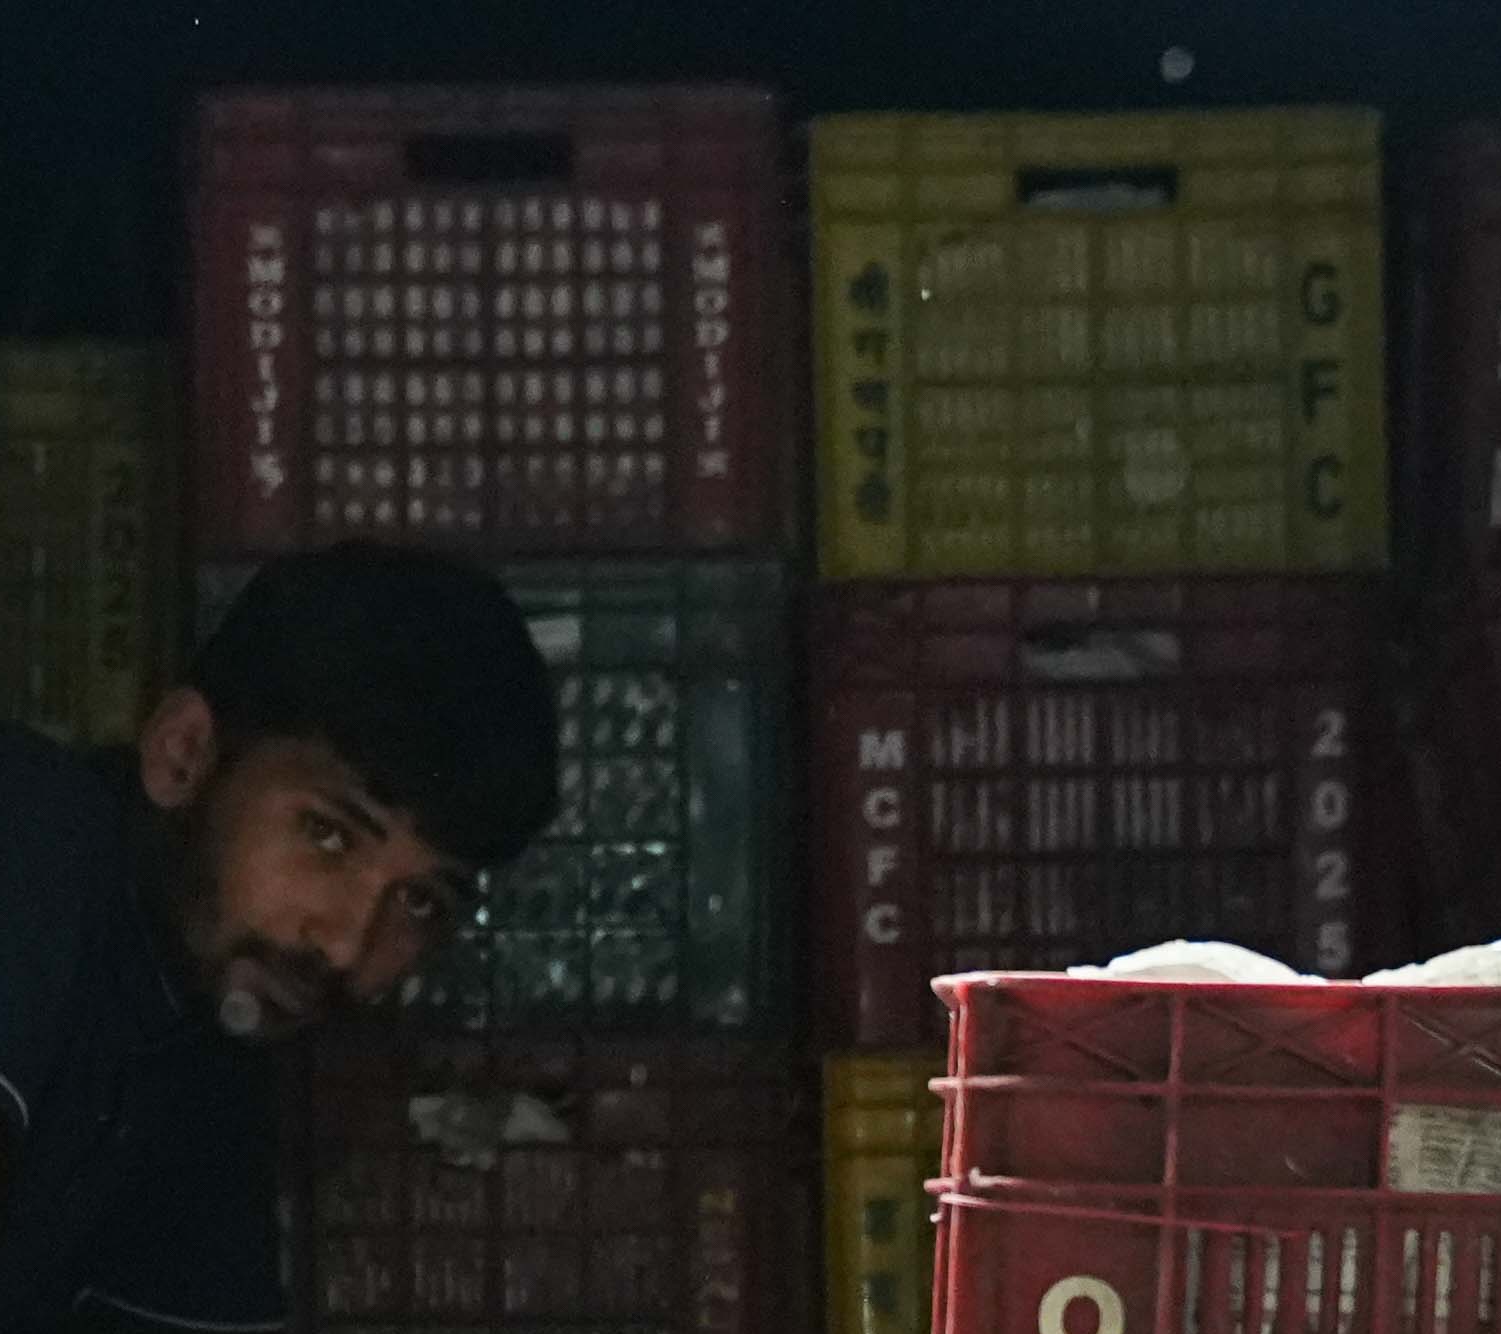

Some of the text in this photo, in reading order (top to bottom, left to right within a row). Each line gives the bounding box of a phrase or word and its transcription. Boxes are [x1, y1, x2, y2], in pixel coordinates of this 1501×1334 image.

[1301, 263, 1343, 517] GFC
[858, 729, 904, 944] MCFC
[1312, 711, 1352, 970] 2025
